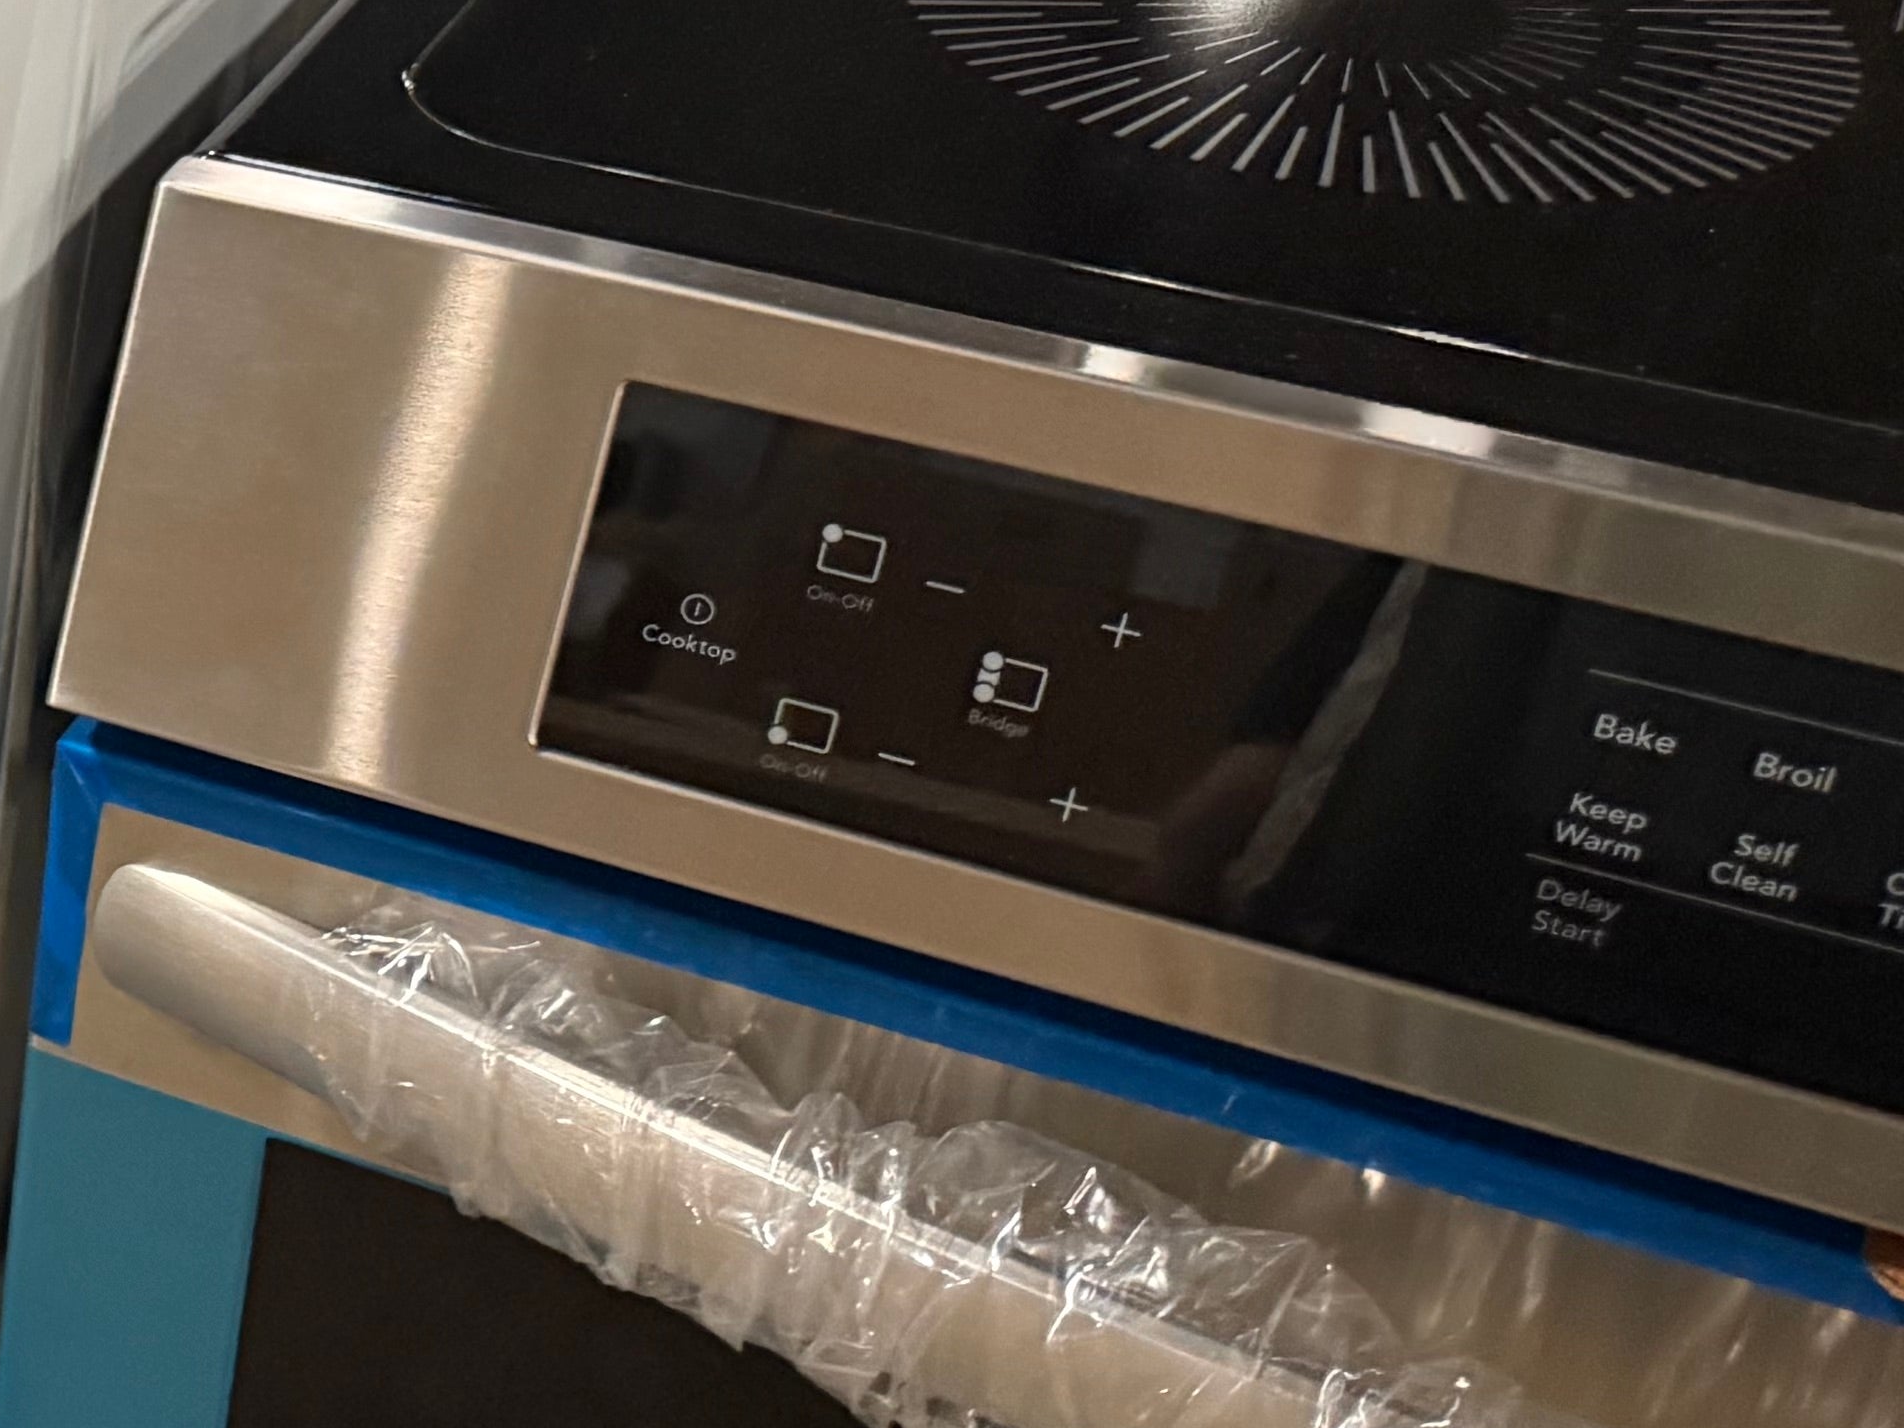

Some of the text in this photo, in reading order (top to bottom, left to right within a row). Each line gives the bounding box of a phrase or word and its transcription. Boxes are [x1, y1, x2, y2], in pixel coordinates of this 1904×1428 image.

[806, 582, 875, 614] On-Off
[641, 622, 737, 666] Cooktop
[967, 707, 1030, 740] Bridge
[1593, 713, 1679, 756] Bake
[1753, 752, 1838, 795] Broil
[1569, 791, 1649, 835] Keep
[1554, 820, 1643, 864] Warm
[1733, 834, 1799, 868] Self
[1536, 878, 1624, 923] Delay
[1709, 861, 1799, 903] Clean
[1531, 909, 1606, 949] Start
